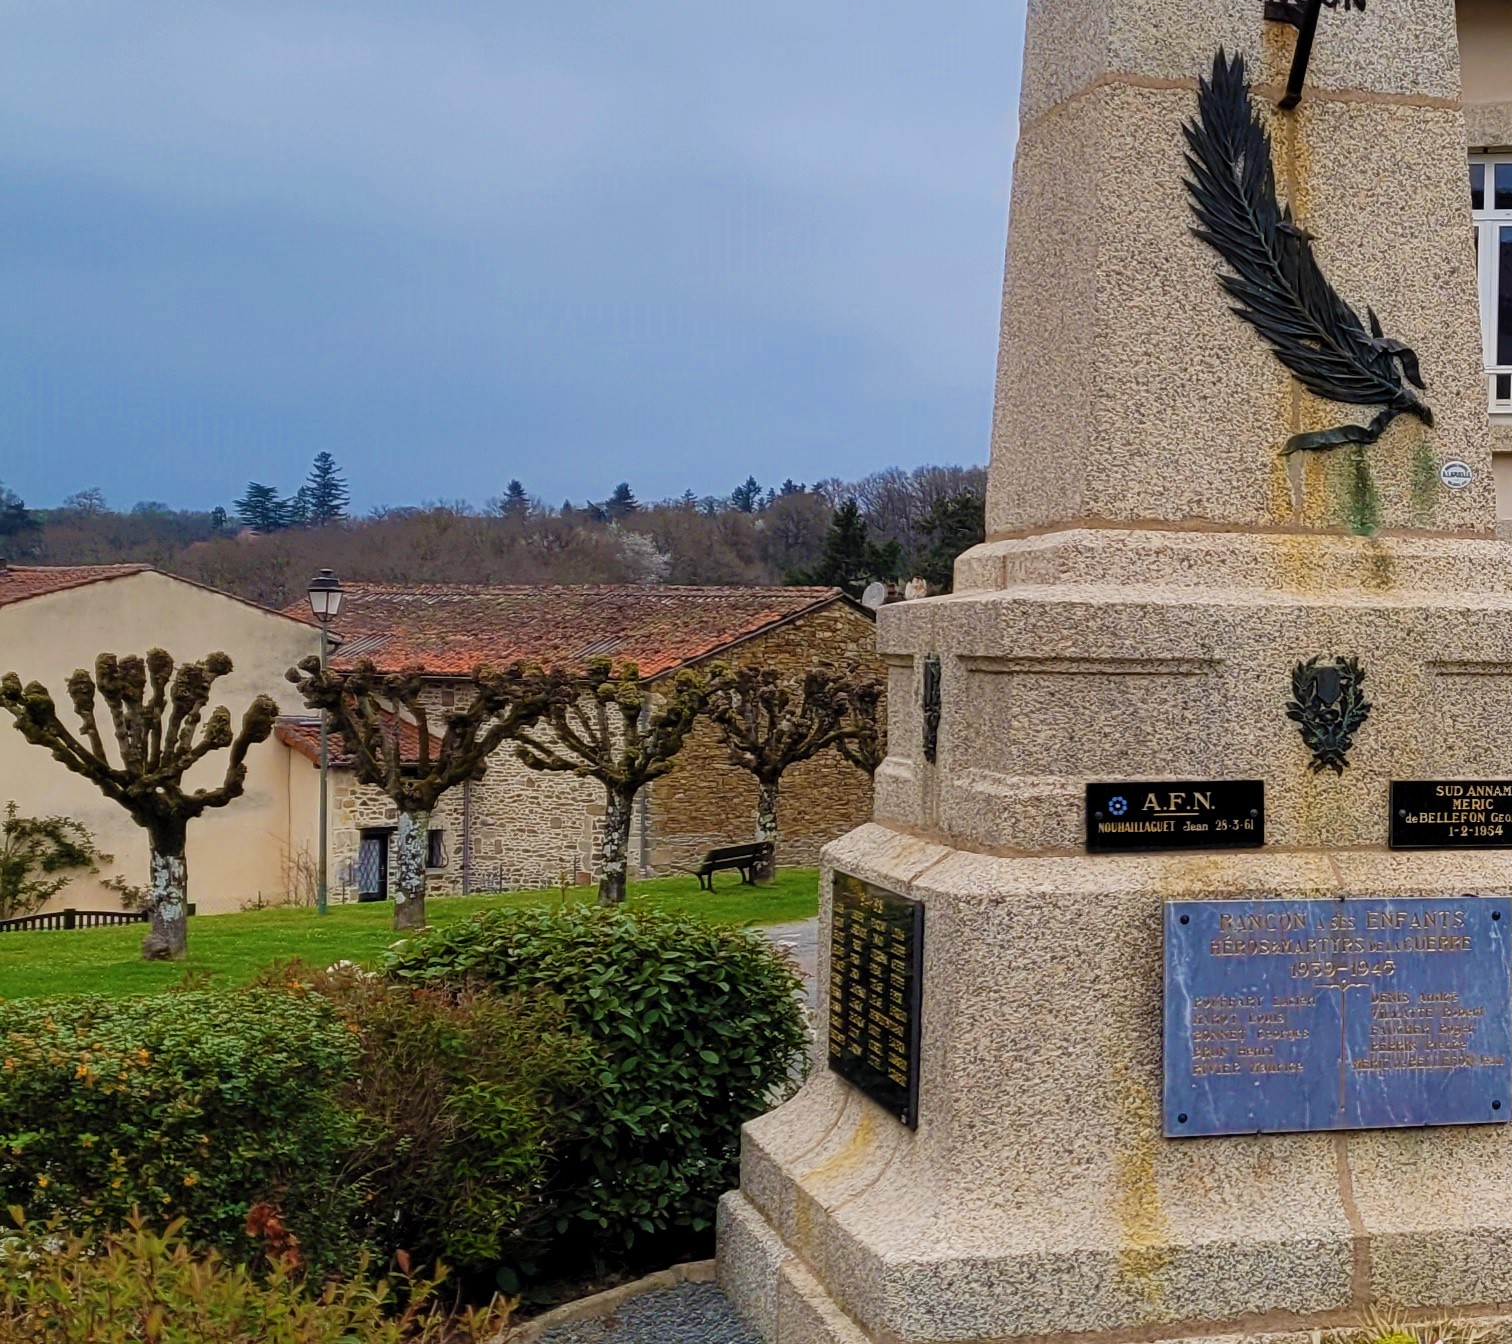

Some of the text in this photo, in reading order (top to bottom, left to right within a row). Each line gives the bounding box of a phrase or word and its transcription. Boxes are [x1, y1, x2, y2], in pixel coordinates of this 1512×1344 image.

[1435, 785, 1512, 797] SUD ANNAM
[1141, 791, 1216, 811] A.F.N.
[1452, 798, 1494, 810] MERIC
[1182, 821, 1208, 832] Jean
[1366, 910, 1466, 930] ENFANTS
[1281, 937, 1365, 955] MARTYRS
[1403, 936, 1473, 953] GUERRE
[1257, 1029, 1310, 1042] Georges
